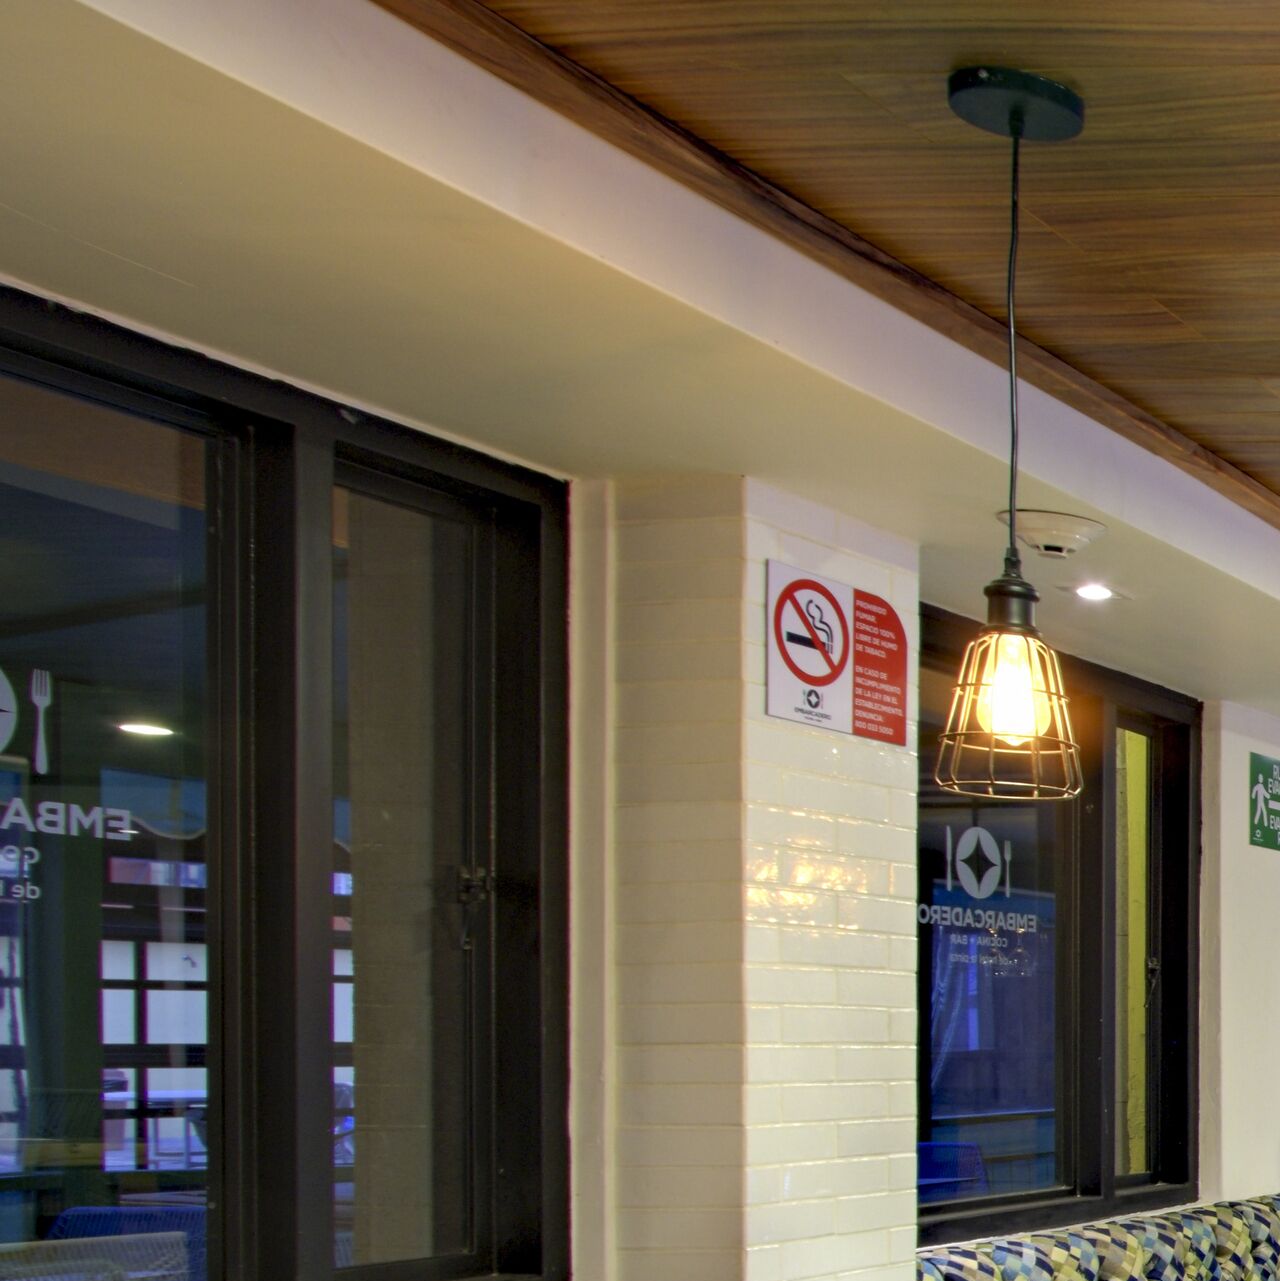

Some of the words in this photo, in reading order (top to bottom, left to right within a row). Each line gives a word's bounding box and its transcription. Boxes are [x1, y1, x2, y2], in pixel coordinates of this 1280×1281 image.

[880, 628, 896, 640] 100%
[856, 643, 864, 652] DE
[855, 665, 863, 674] EN
[864, 668, 880, 678] CASO
[880, 671, 888, 681] DE
[855, 687, 863, 696] DE
